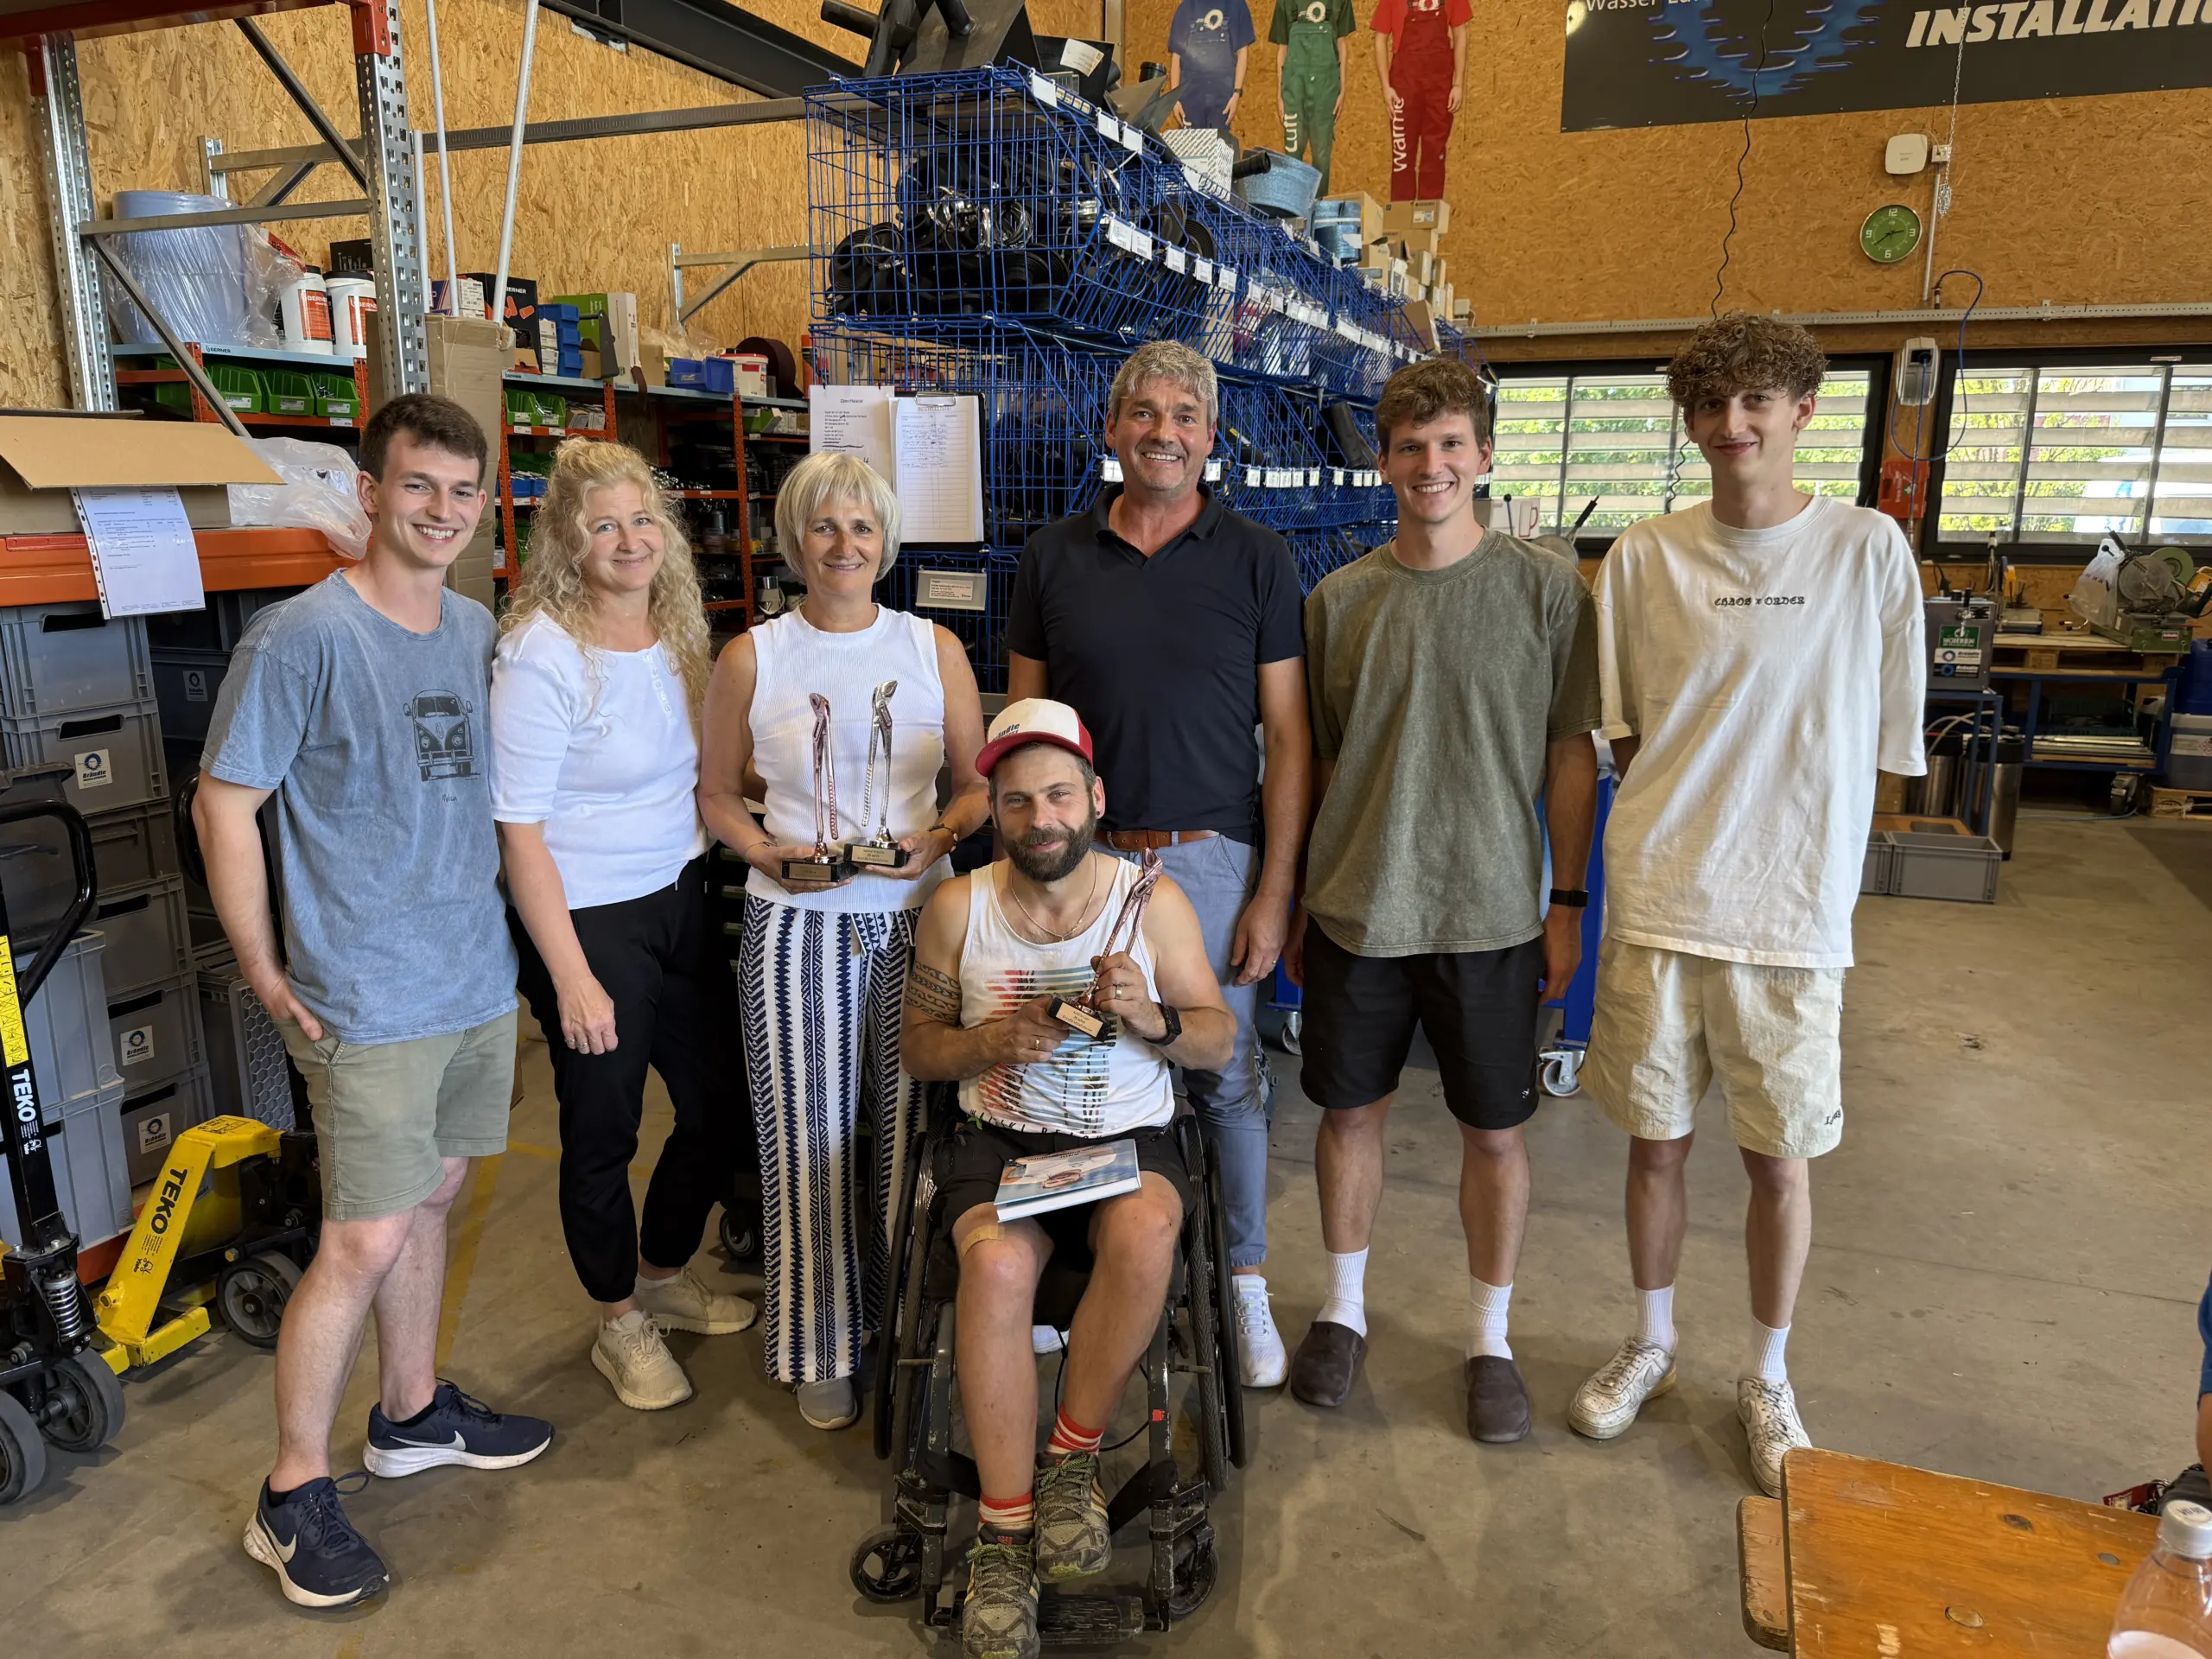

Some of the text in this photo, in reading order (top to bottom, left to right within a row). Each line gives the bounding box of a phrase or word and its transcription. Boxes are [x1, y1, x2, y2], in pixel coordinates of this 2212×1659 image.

[1585, 0, 1656, 11] Wasser
[1889, 208, 1898, 217] 12
[1866, 228, 1916, 238] 9 3
[1885, 250, 1891, 258] 6
[1764, 596, 1805, 606] ORDER
[11, 1068, 36, 1122] TEKO
[150, 1168, 188, 1235] TEKO
